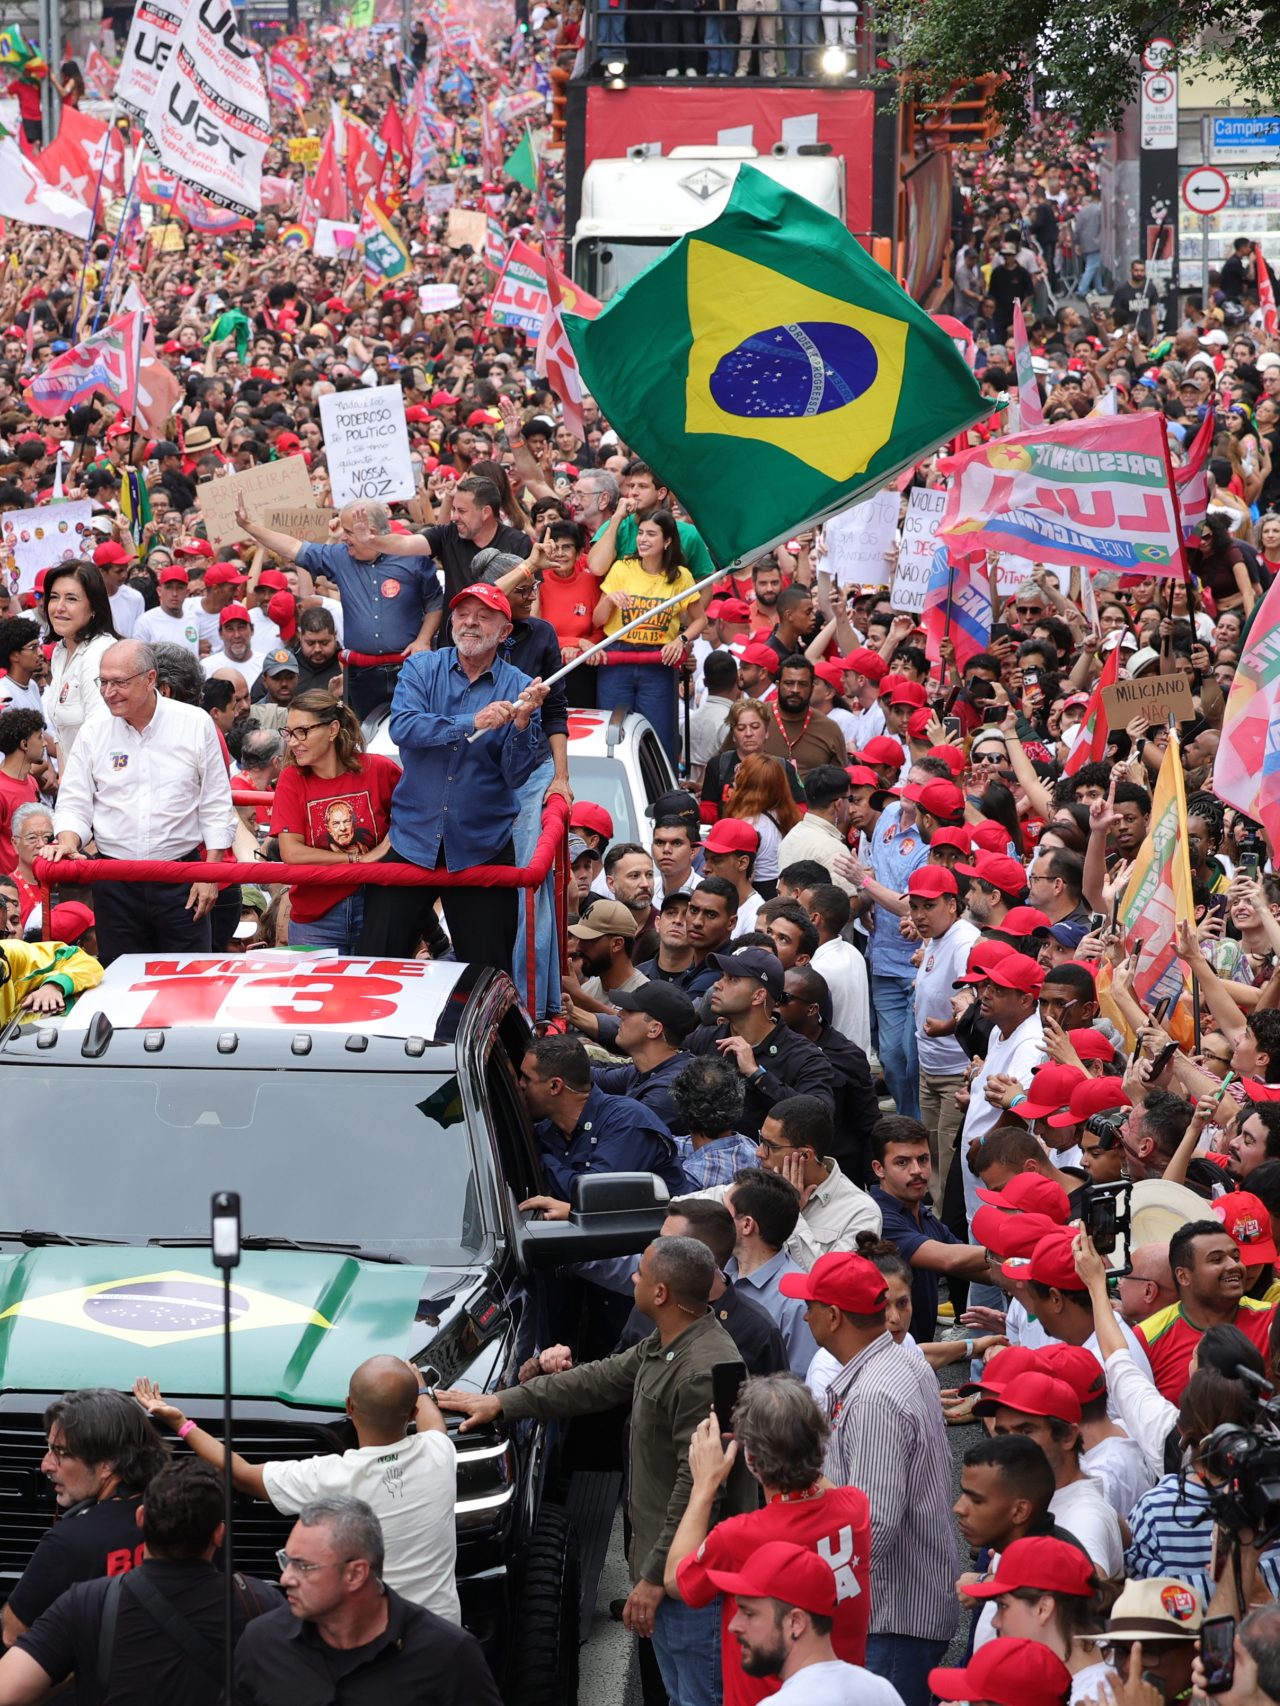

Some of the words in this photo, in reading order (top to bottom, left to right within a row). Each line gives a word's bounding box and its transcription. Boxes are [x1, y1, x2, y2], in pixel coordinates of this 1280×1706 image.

[199, 0, 252, 59] UG
[135, 32, 173, 72] UG
[1148, 47, 1169, 61] 50
[169, 81, 247, 165] UGT
[235, 109, 256, 124] UGT
[229, 117, 250, 132] UGT
[248, 126, 269, 141] UGT
[1214, 118, 1280, 138] Campinas
[208, 193, 231, 209] UGT
[230, 202, 252, 218] UGT
[367, 234, 401, 269] 13
[806, 360, 823, 414] PROGRESSO
[335, 408, 393, 428] PODEROSO
[351, 465, 390, 484] NOSSA
[209, 469, 292, 505] BRASILEIRA
[349, 479, 397, 499] VOZ
[271, 510, 327, 528] MILICIANO
[905, 517, 923, 534] OS
[900, 541, 910, 557] A
[896, 561, 920, 581] NÃO
[627, 630, 649, 641] LULA
[650, 631, 659, 642] 13
[1116, 680, 1185, 703] MILICIANO
[1141, 698, 1172, 722] NÃO
[112, 754, 129, 768] 13
[144, 958, 430, 977] VOTE
[128, 974, 404, 1029] 13
[816, 1523, 854, 1572] U
[833, 1563, 862, 1605] A
